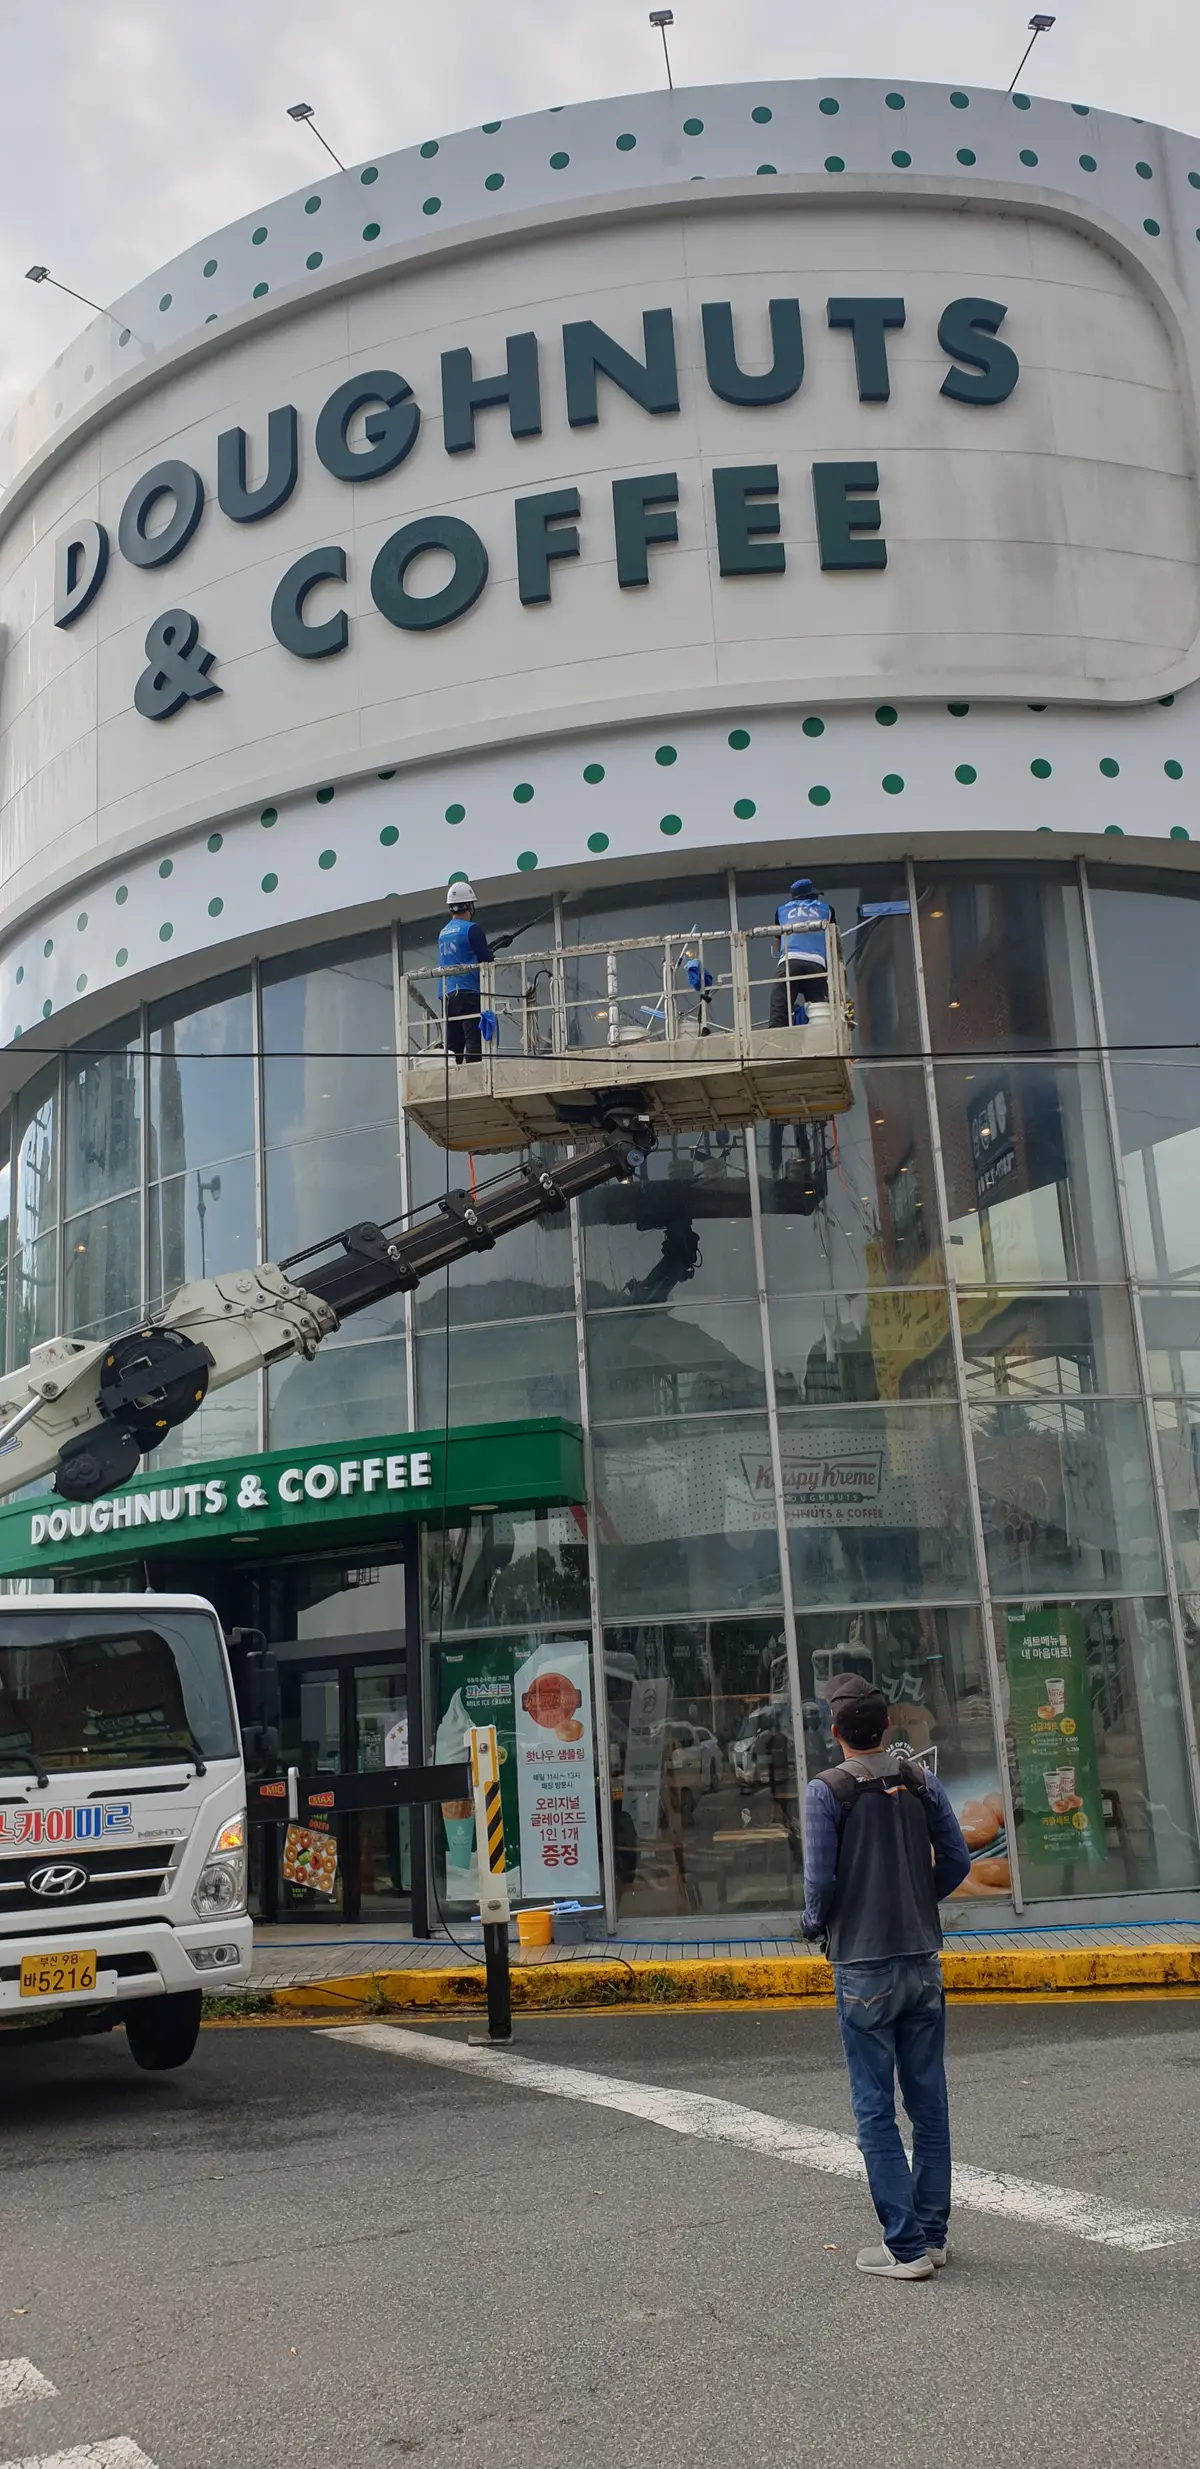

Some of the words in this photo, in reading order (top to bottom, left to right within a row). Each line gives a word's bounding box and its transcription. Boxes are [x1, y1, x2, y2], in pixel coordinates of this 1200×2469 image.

[54, 297, 1020, 630] DOUGHNUTS
[134, 607, 223, 721] &
[270, 460, 888, 660] COFFEE
[755, 1462, 821, 1492] Kispy
[821, 1462, 878, 1488] Kreme
[31, 1480, 226, 1545] DOUGHNUTS
[237, 1475, 269, 1509] &
[278, 1452, 432, 1503] COFFEE
[785, 1494, 859, 1503] OUGHNUTS
[836, 1509, 844, 1519] &
[848, 1508, 884, 1519] COFFEE
[1023, 1635, 1068, 1647] 세트메뉴를
[1021, 1648, 1031, 1660] 내
[1033, 1647, 1072, 1659] 마음대로!
[466, 1699, 481, 1707] MILK
[491, 1698, 511, 1706] CREAM
[526, 1750, 554, 1762] 핫나우
[557, 1748, 585, 1761] 샘플링
[266, 1784, 285, 1794] MID
[312, 1794, 332, 1803] MAX
[535, 1796, 580, 1811] 오리지널
[530, 1811, 587, 1827] 글레이즈드
[138, 1827, 187, 1839] MIGHTY
[540, 1828, 557, 1842] 1인
[561, 1828, 579, 1841] 1개
[541, 1843, 579, 1867] 증정
[40, 1955, 58, 1967] 부산
[62, 1953, 79, 1965] 98
